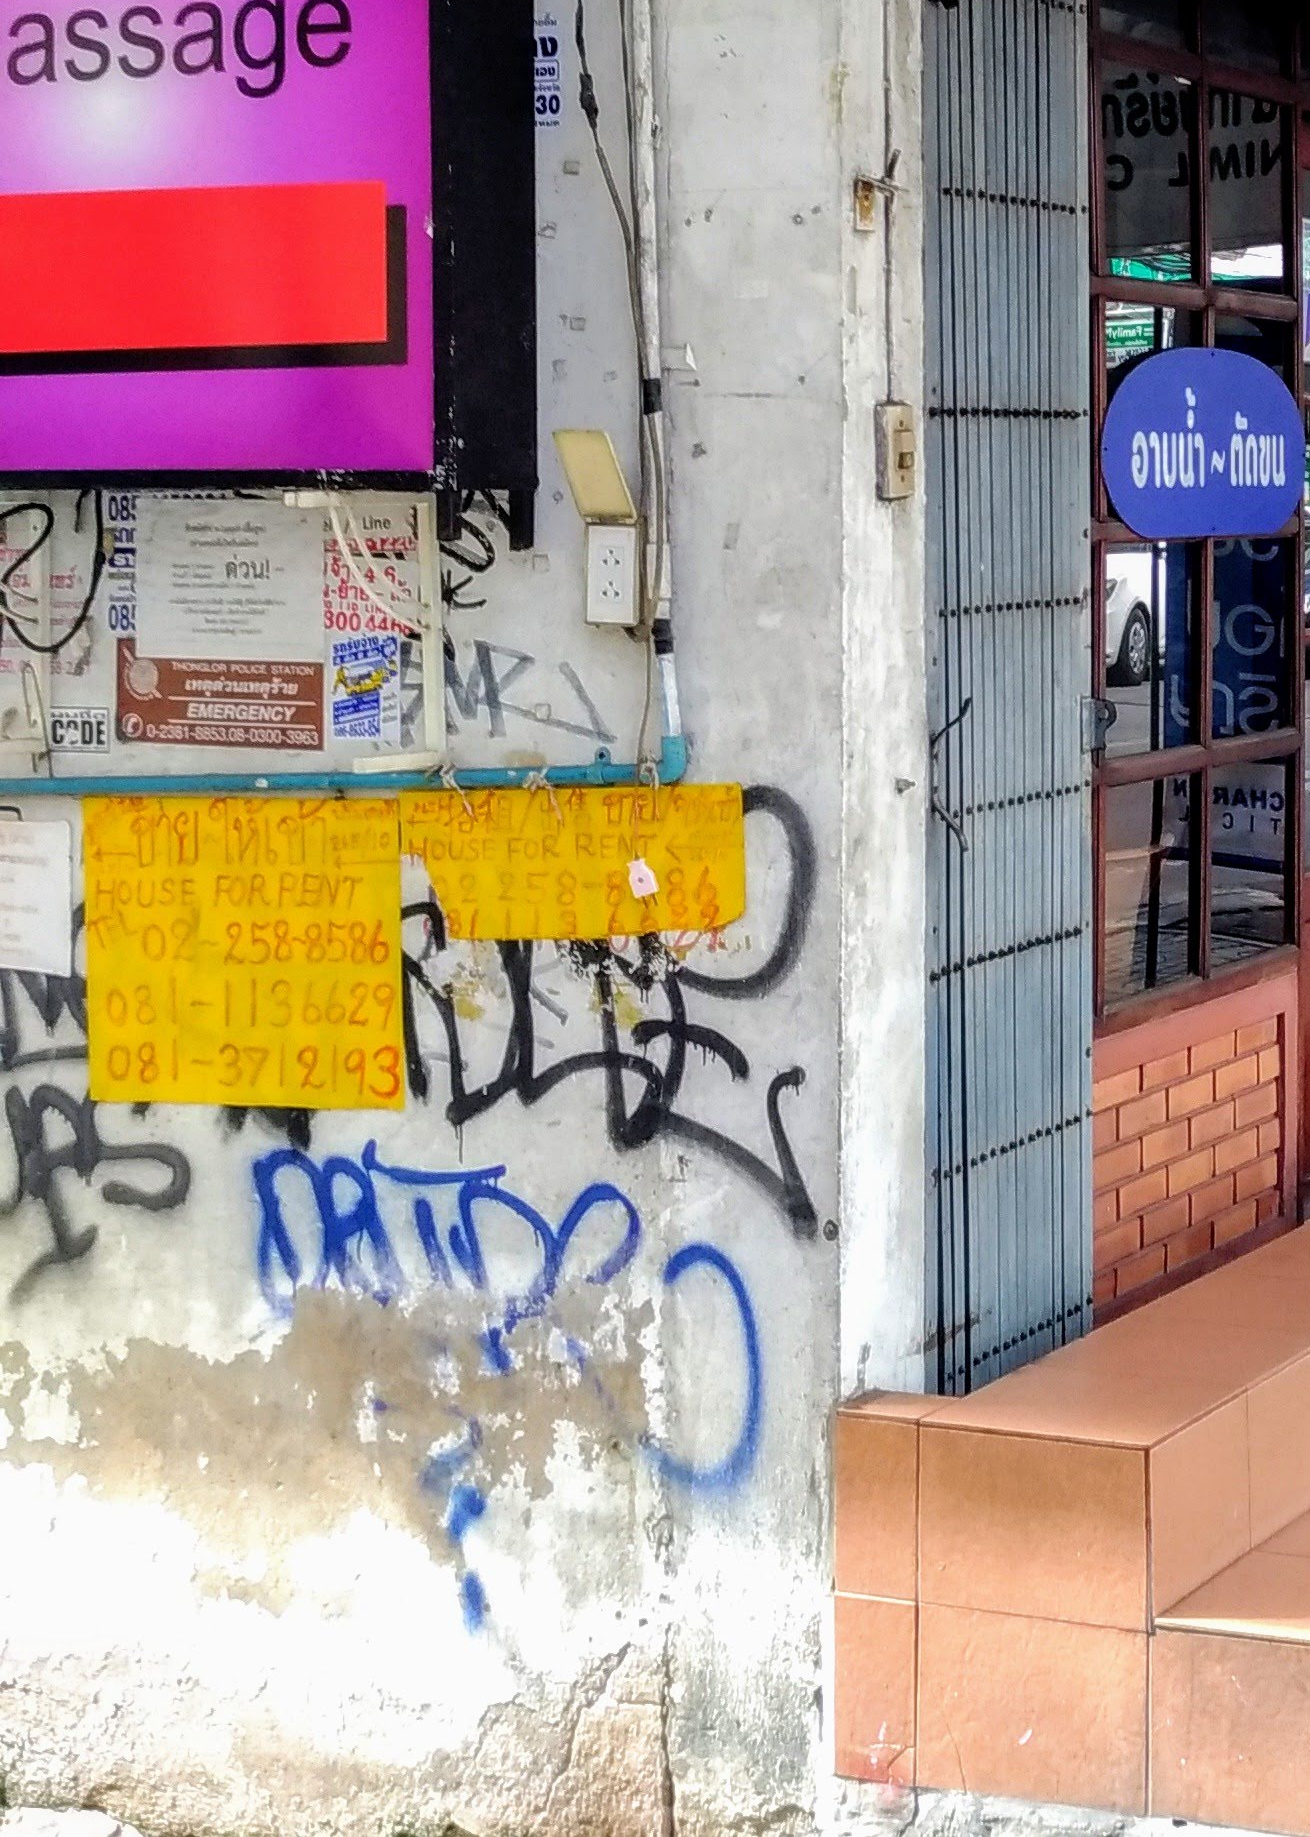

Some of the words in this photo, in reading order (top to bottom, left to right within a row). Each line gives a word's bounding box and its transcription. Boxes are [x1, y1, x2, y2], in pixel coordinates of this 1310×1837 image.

[1131, 385, 1205, 490] อาบน้ำ
[1229, 410, 1286, 488] ตัดขน
[224, 554, 271, 580] ด่วน!
[230, 663, 268, 676] POLICE
[271, 664, 315, 677] STATION
[186, 703, 297, 722] EMERGENCY
[408, 836, 496, 866] HOUSE
[507, 834, 560, 862] FOR
[575, 833, 658, 862] RENT
[95, 876, 197, 911] HOUSE
[211, 872, 272, 909] FOR
[106, 977, 396, 1032] 081-1136629
[106, 1037, 401, 1100] 081-3712193
